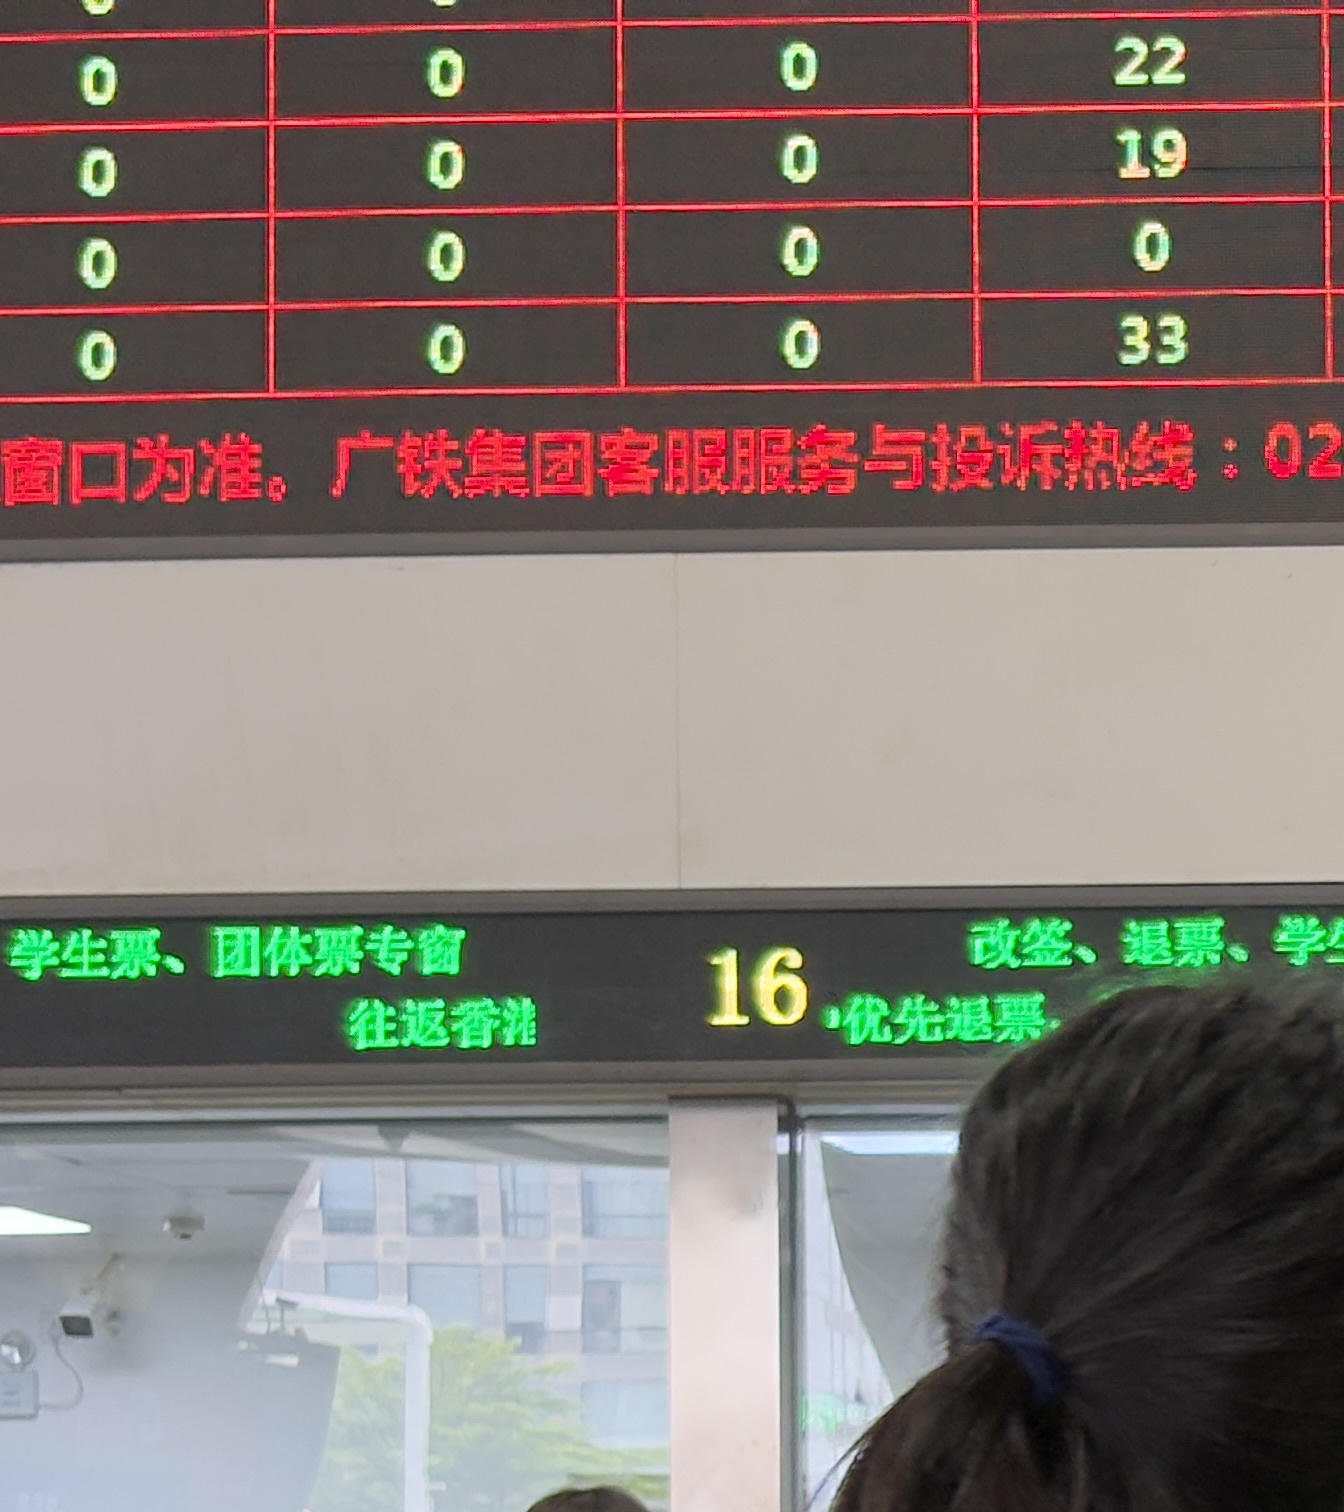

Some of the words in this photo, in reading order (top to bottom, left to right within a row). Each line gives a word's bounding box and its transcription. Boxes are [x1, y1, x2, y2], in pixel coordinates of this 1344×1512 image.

[81, 57, 117, 105] 0
[428, 49, 464, 97] 0
[781, 42, 817, 90] 0
[1115, 36, 1185, 84] 22
[80, 149, 116, 197] 0
[428, 141, 464, 189] 0
[782, 135, 817, 183] 0
[1117, 128, 1186, 178] 19
[80, 239, 116, 288] 0
[428, 232, 464, 281] 0
[782, 226, 819, 276] 0
[1134, 222, 1169, 271] 0
[79, 331, 116, 380] 0
[428, 325, 463, 373] 0
[782, 320, 818, 368] 0
[1120, 315, 1187, 364] 33
[6, 924, 466, 980] 学生票、团体票专窗
[711, 949, 807, 1025] 16
